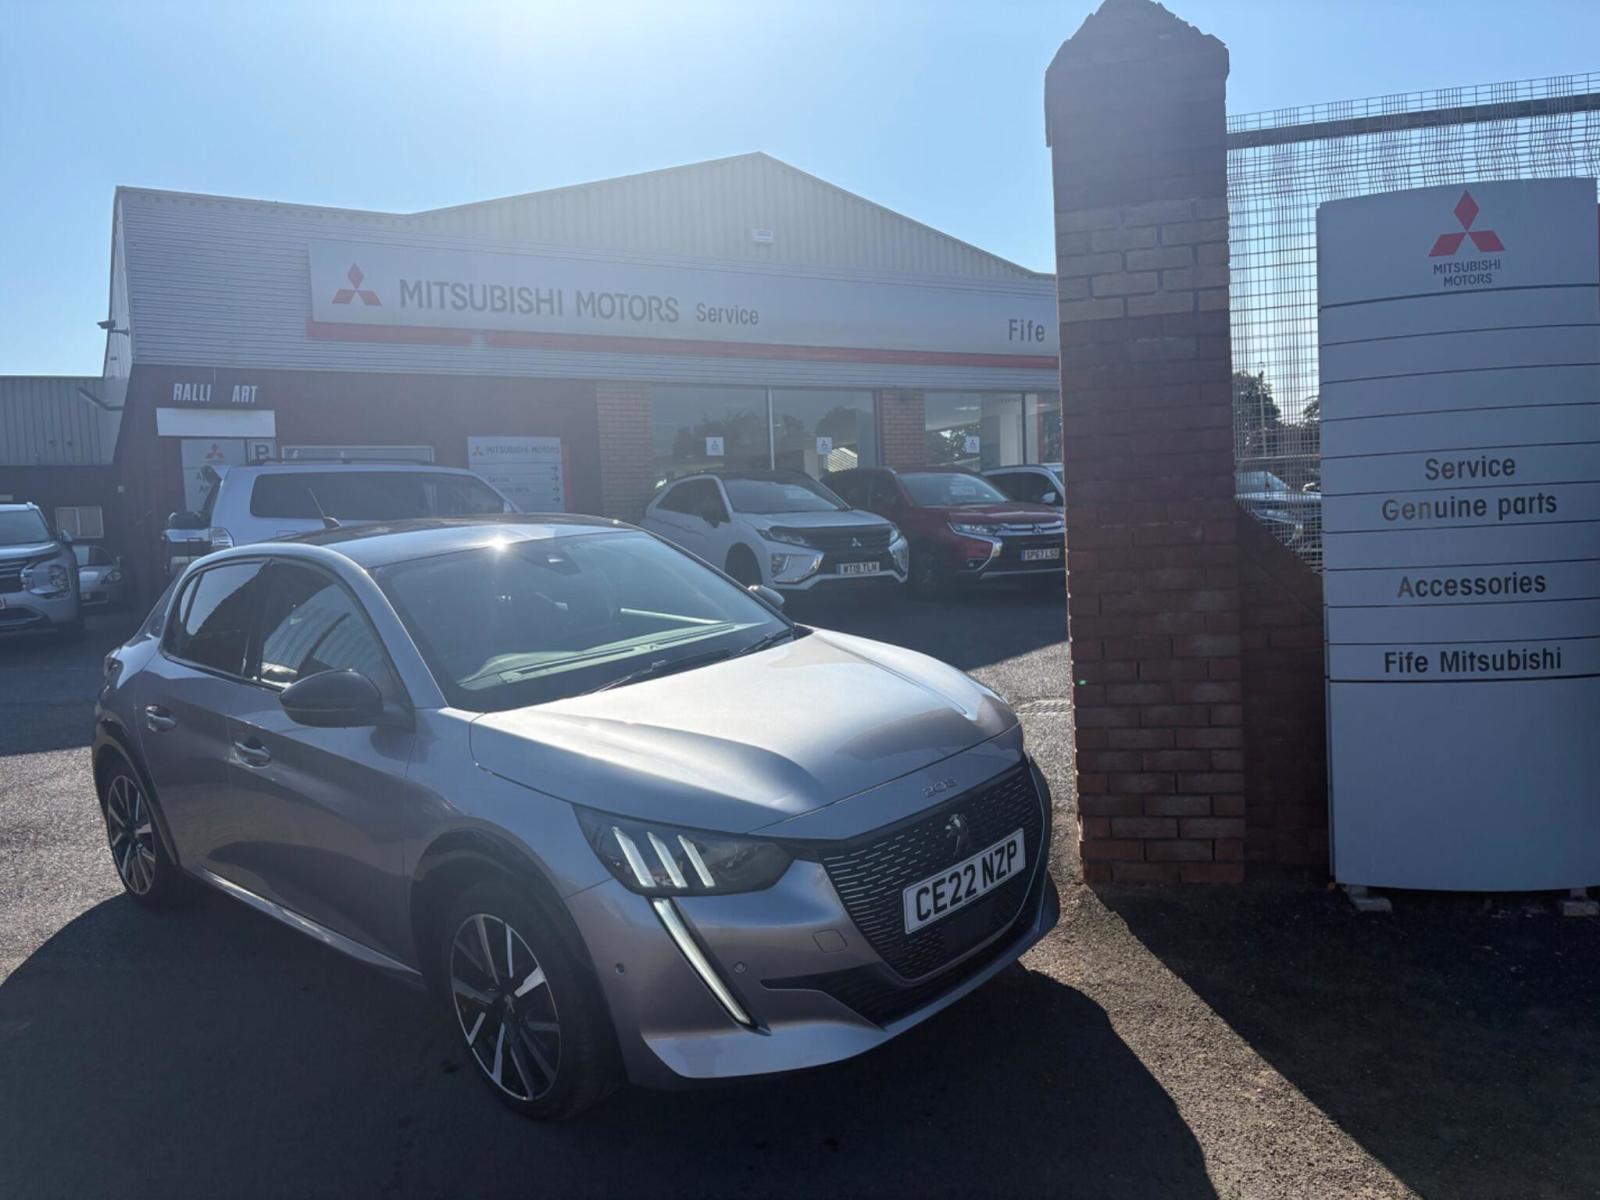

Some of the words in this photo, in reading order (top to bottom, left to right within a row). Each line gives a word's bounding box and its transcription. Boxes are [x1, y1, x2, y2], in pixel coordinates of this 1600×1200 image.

[1433, 259, 1501, 275] MITSUBISHI
[1443, 272, 1493, 287] MOTORS
[399, 278, 563, 316] MITSUBISHI
[576, 289, 680, 324] MOTORS
[696, 302, 759, 326] Service
[1008, 318, 1046, 343] Fife
[173, 383, 212, 402] RALLI
[232, 384, 259, 403] ART
[1424, 455, 1516, 480] Service
[1382, 496, 1487, 521] Genuine
[1498, 492, 1558, 521] parts
[1397, 571, 1547, 598] Accessories
[1384, 651, 1429, 673] Fife
[1440, 647, 1562, 673] Mitsubishi
[915, 863, 977, 922] CE22
[982, 839, 1017, 889] NZP
